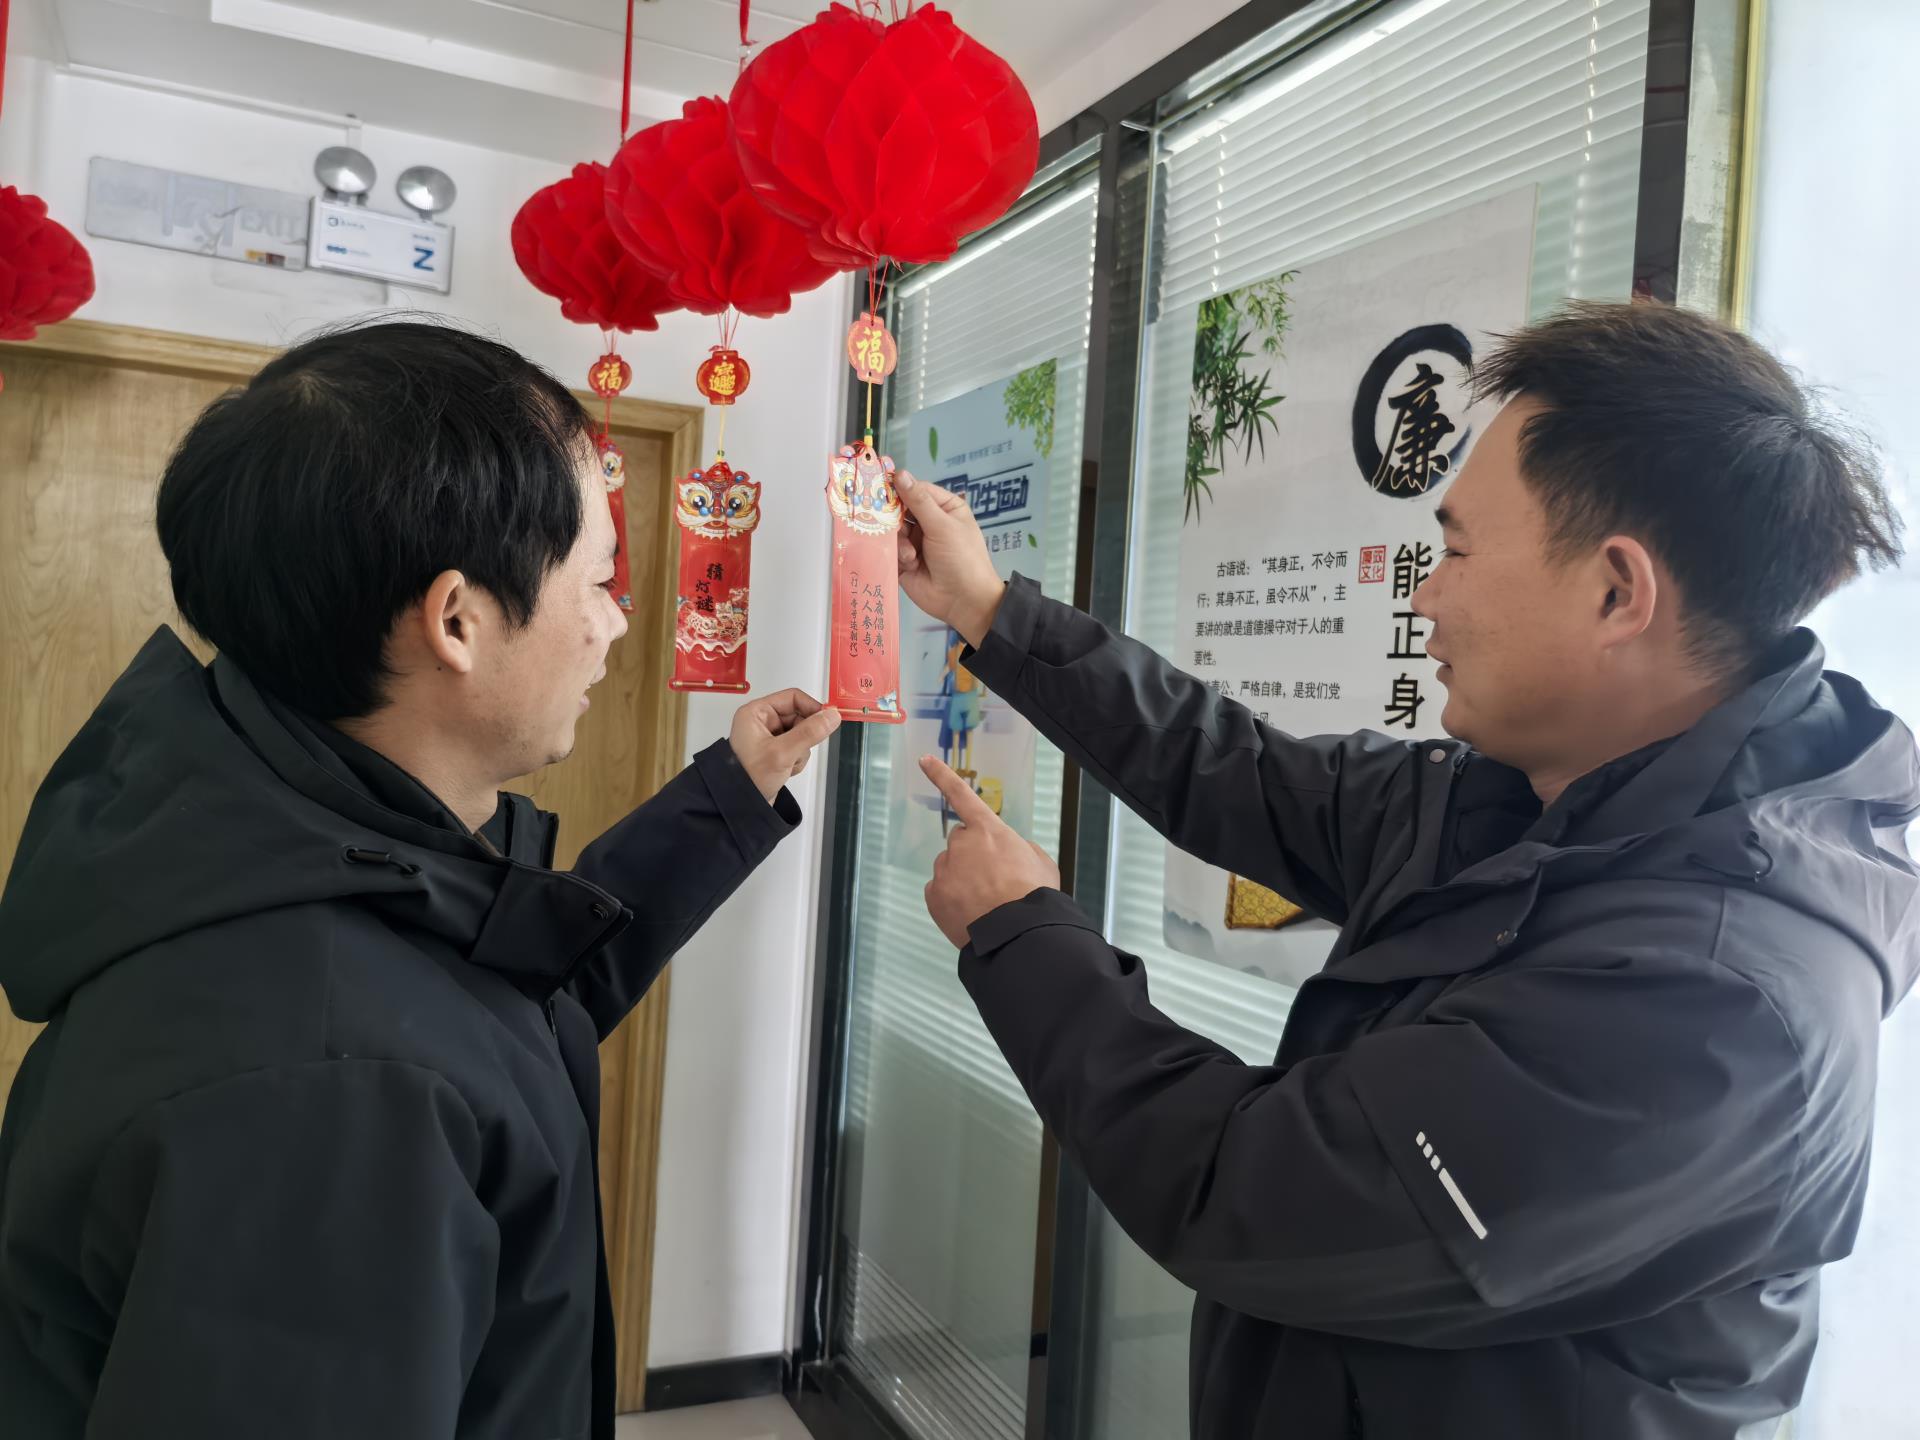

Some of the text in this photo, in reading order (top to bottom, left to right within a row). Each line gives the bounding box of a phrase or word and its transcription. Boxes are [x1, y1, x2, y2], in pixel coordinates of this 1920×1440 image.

[856, 326, 885, 373] 福
[597, 361, 623, 390] 福
[1372, 363, 1455, 492] 廉
[1195, 617, 1345, 637] 要讲的就是道德操守对于人的重
[1383, 541, 1433, 730] 能正身
